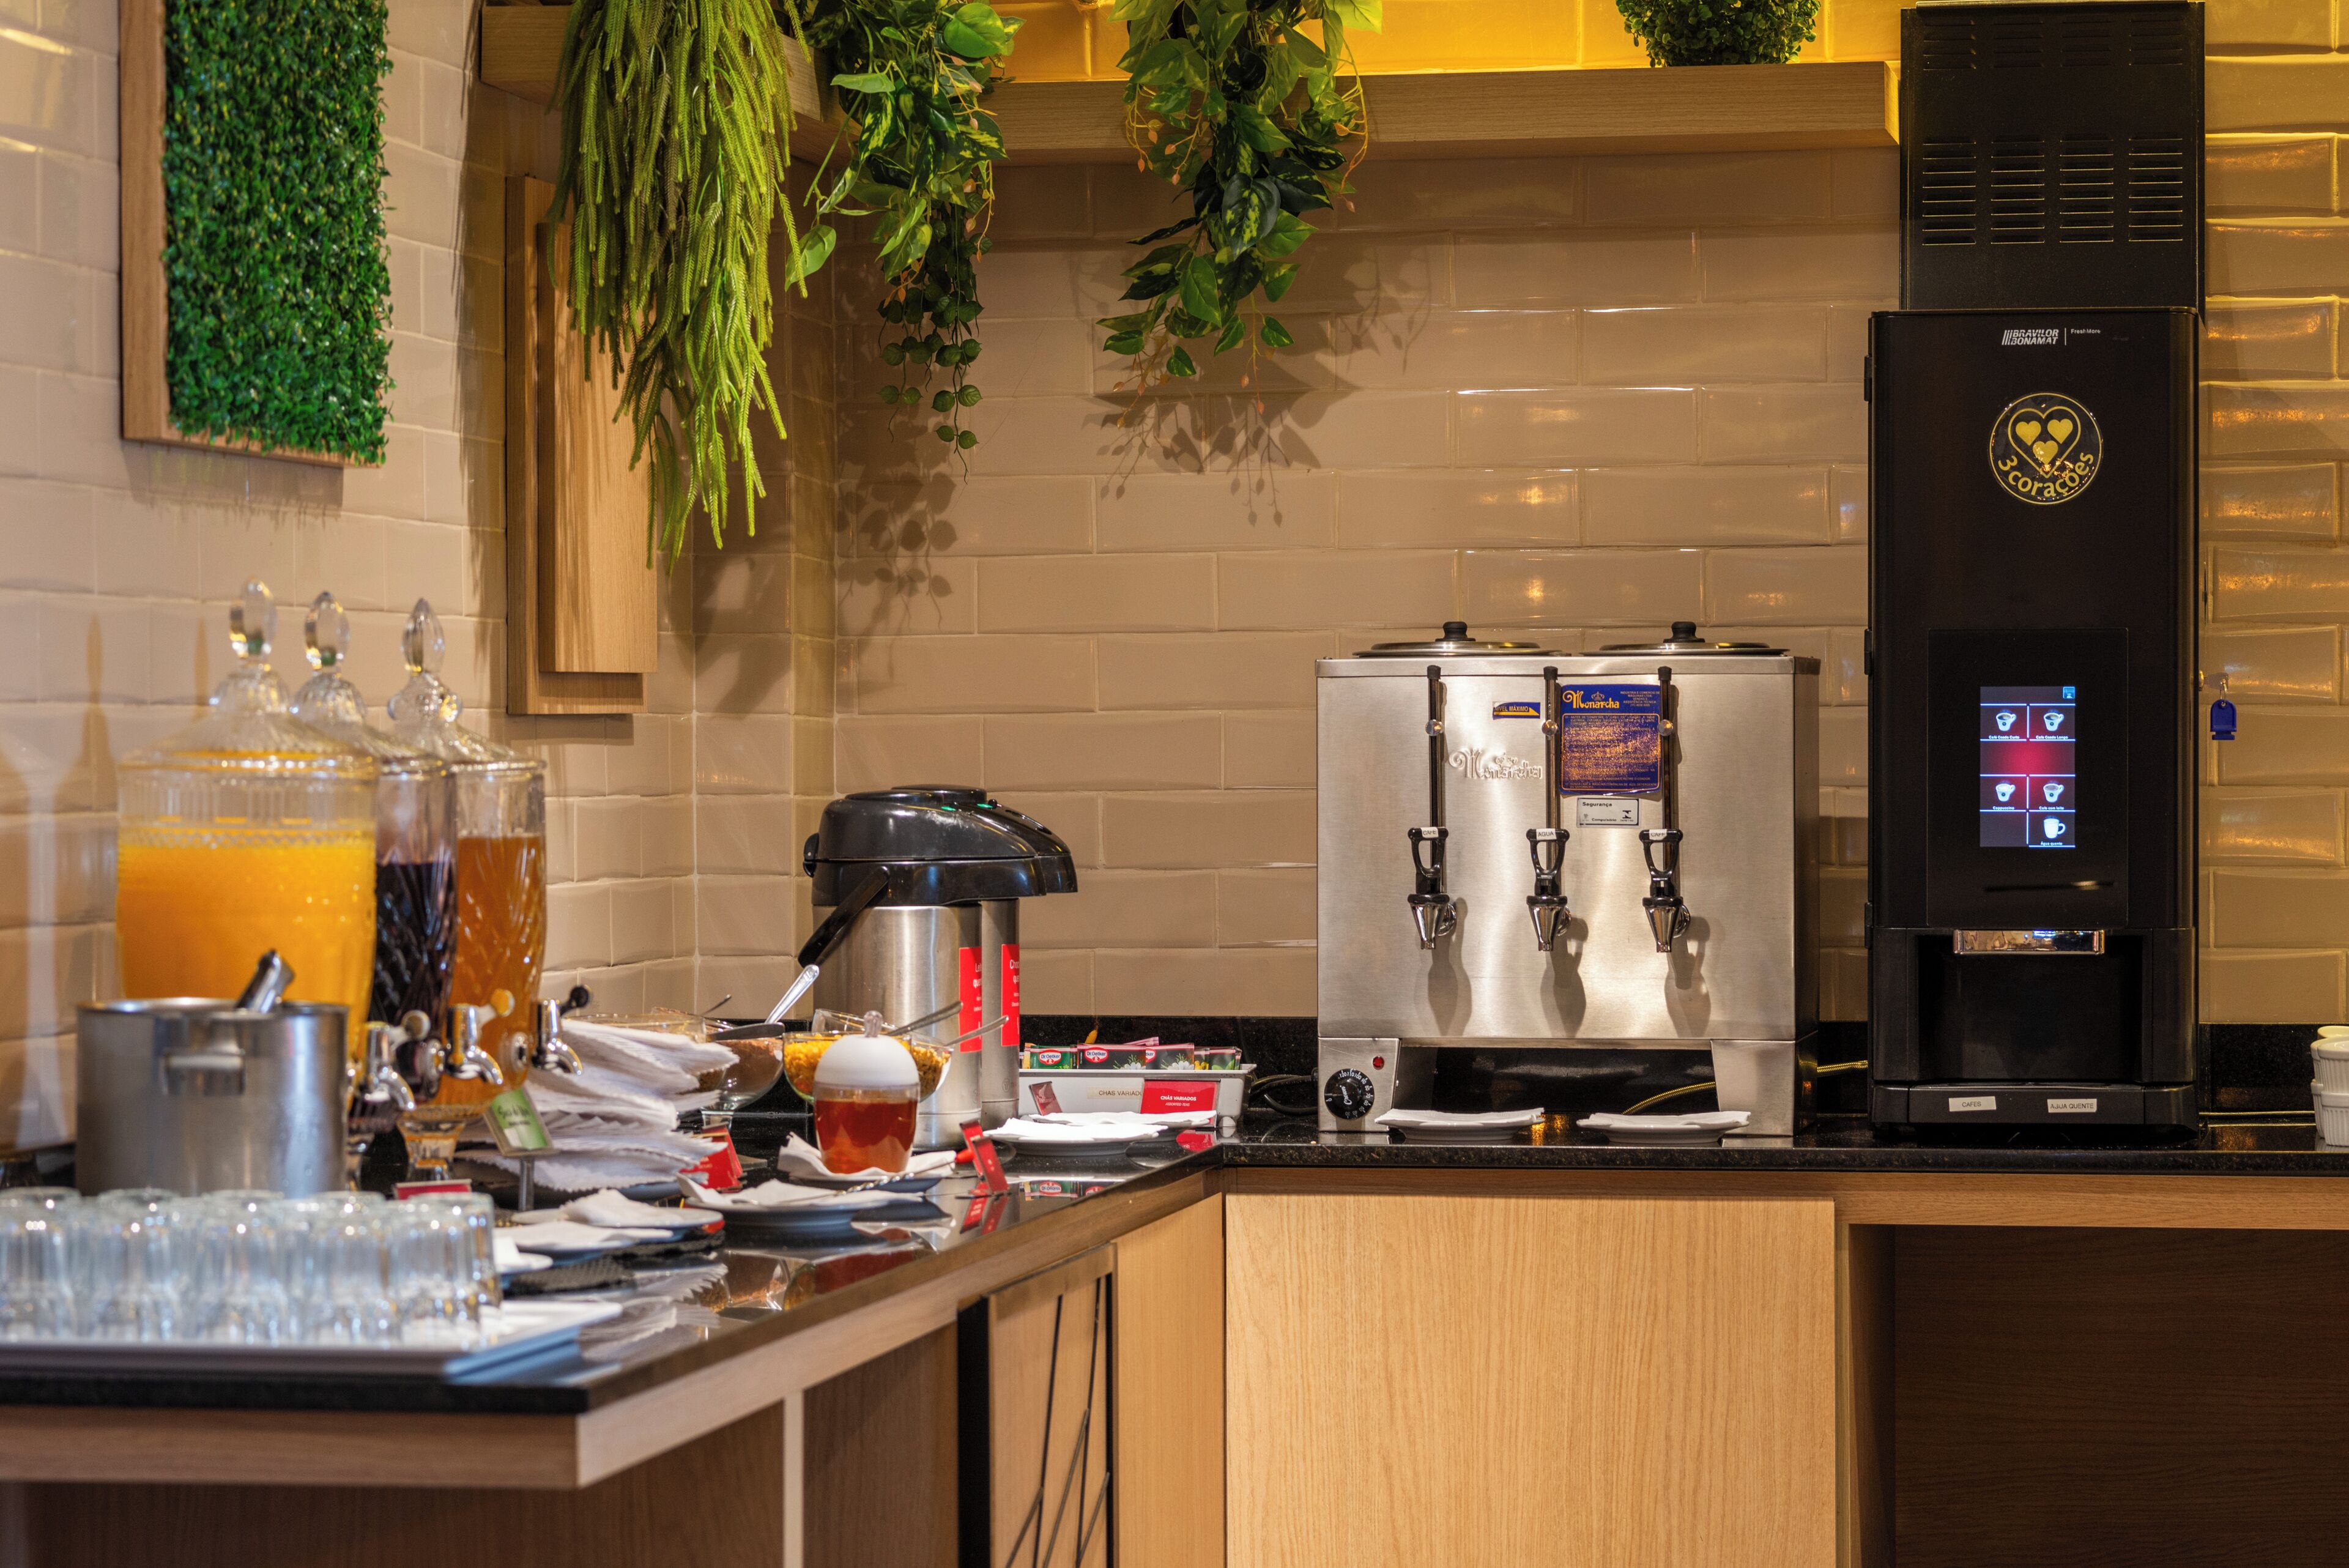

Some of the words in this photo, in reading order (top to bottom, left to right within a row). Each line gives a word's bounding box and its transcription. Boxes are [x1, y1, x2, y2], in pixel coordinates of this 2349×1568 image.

[2010, 337, 2058, 346] BONAMAT
[1998, 455, 2017, 470] 3
[1562, 690, 1620, 708] Monarcha
[1449, 748, 1543, 779] Monarcha
